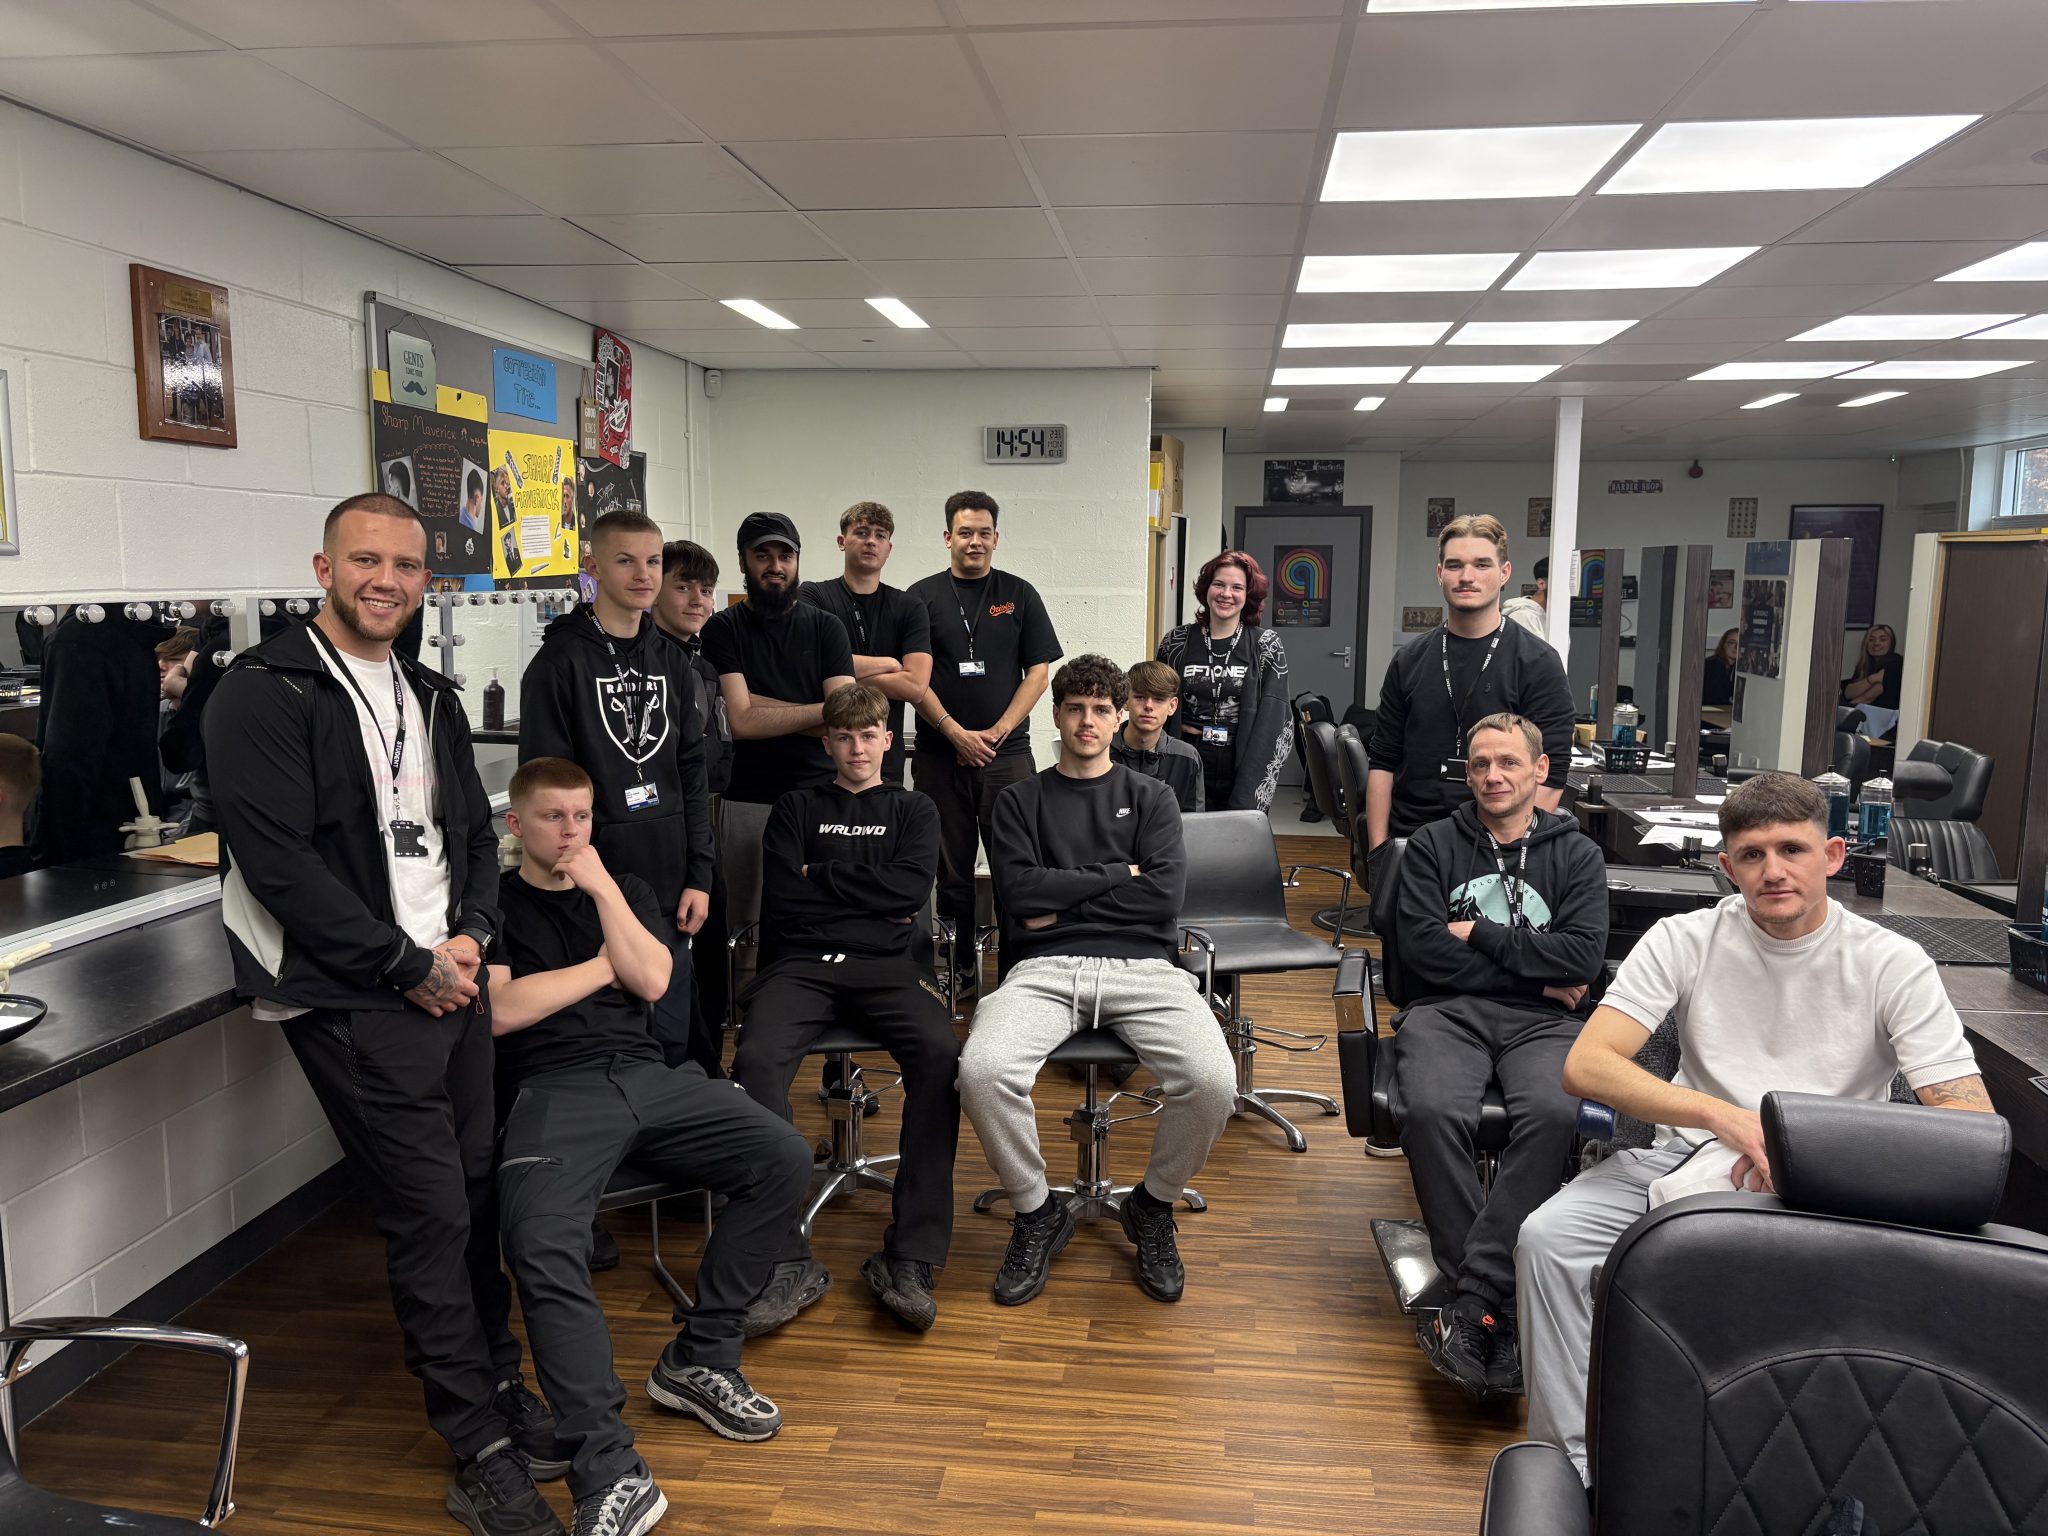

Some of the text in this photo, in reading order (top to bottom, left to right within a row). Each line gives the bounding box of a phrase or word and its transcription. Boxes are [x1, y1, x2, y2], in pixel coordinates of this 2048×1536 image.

[403, 350, 425, 369] GENTS
[997, 429, 1044, 457] 14:54
[521, 453, 554, 484] SHARP
[515, 488, 560, 511] MAVERICK
[393, 741, 402, 769] STUDENT
[1519, 846, 1527, 869] STUDENT
[1503, 880, 1514, 904] STUDENT
